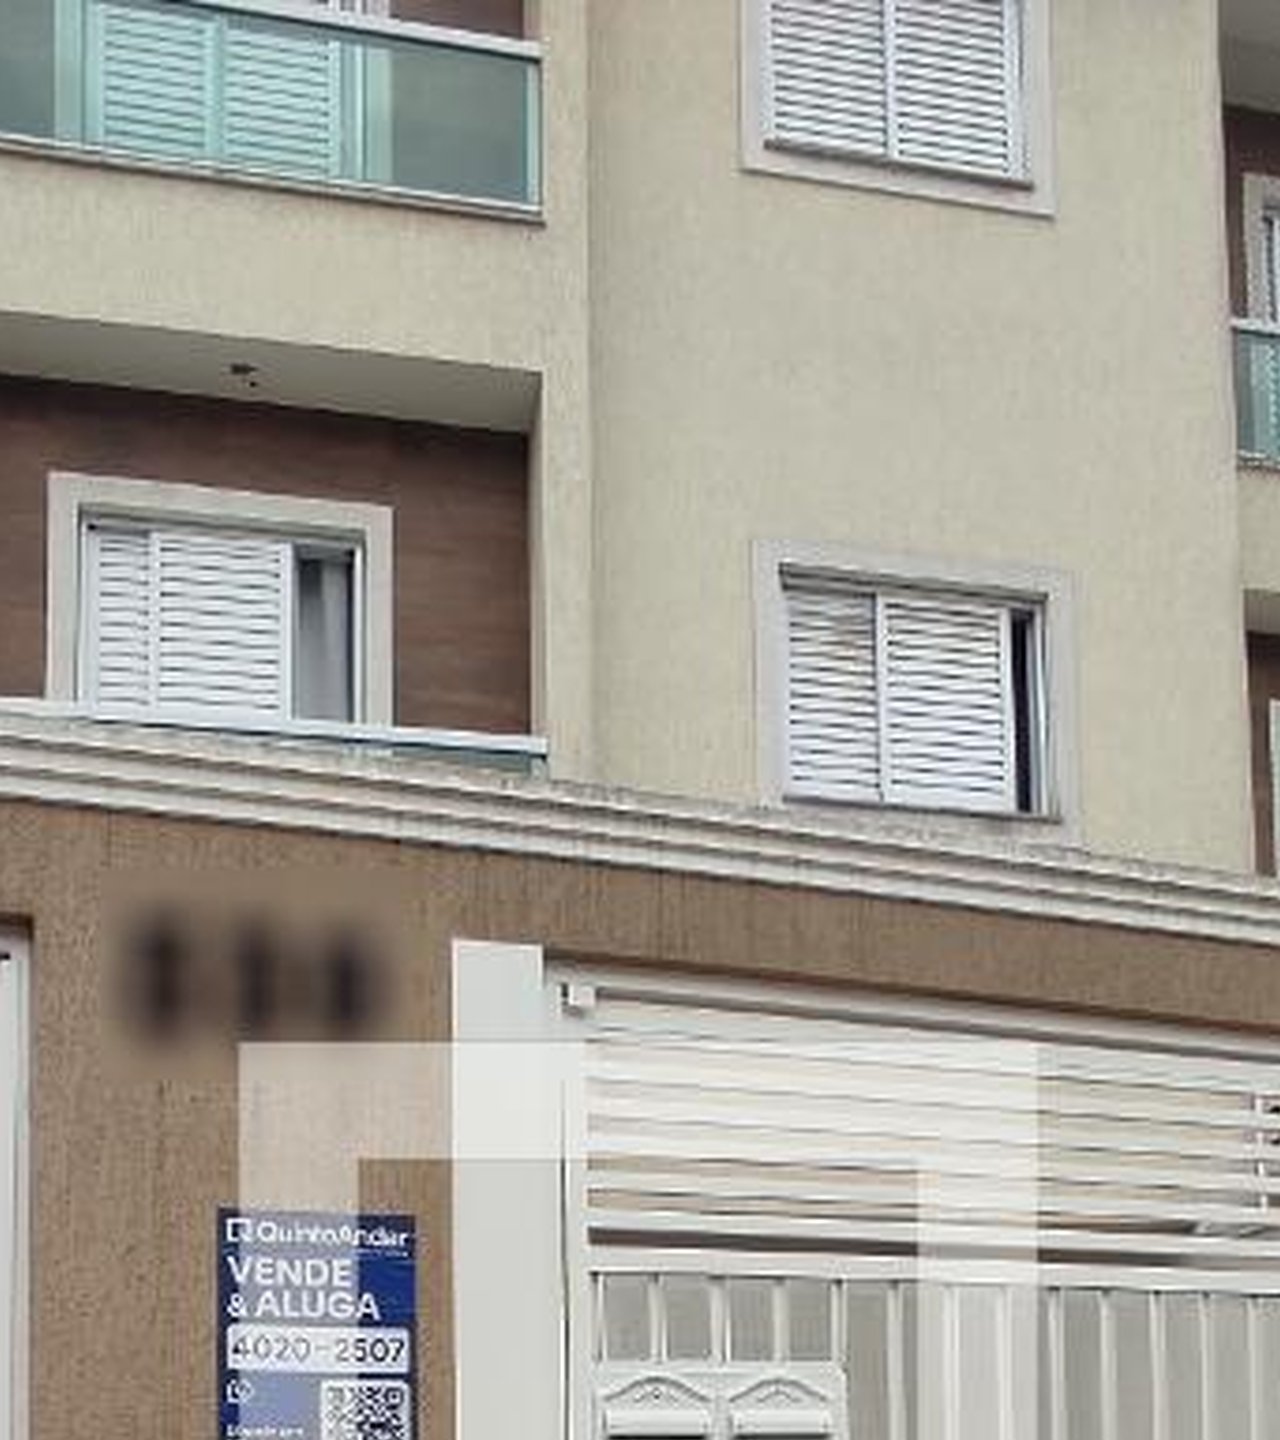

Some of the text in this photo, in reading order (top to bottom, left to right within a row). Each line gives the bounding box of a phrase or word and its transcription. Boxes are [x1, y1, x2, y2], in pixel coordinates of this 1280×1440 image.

[226, 1256, 353, 1287] VENDE
[226, 1290, 382, 1320] & ALUGA
